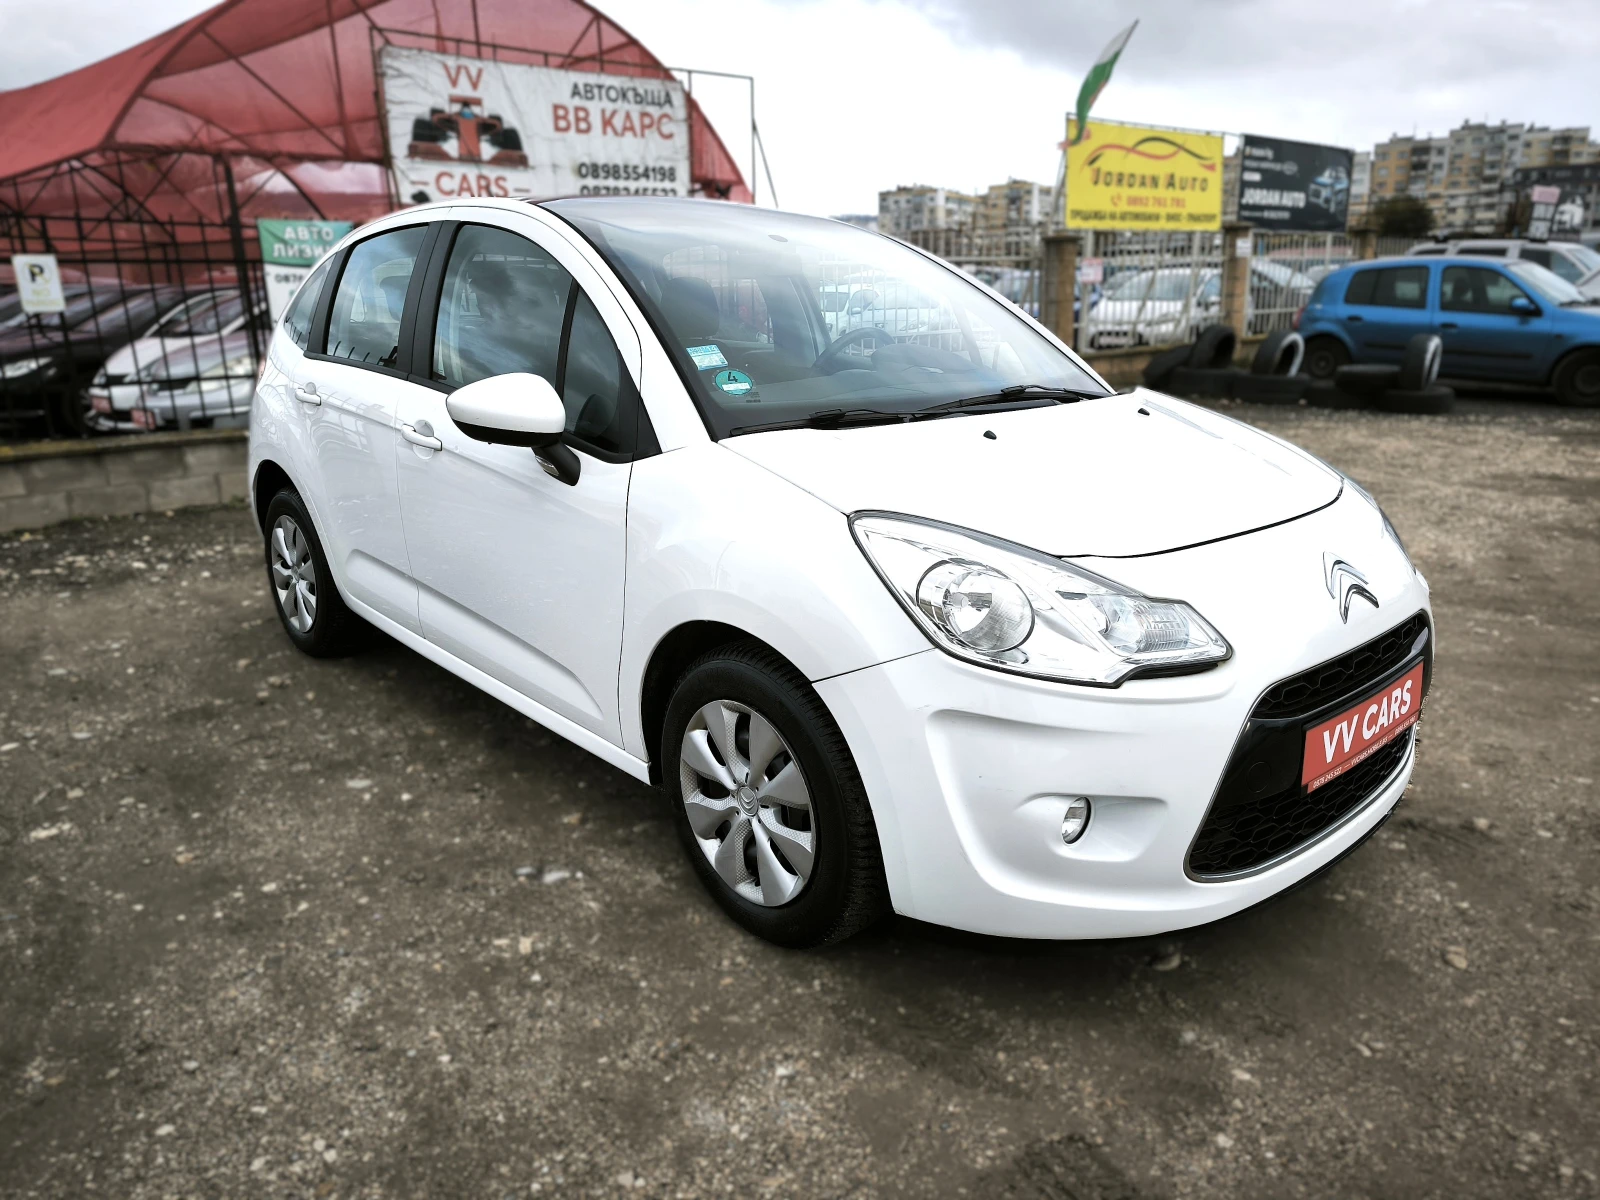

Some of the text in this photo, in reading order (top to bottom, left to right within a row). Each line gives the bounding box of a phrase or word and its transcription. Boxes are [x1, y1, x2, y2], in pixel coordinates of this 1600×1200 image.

[442, 62, 483, 91] VV
[571, 82, 674, 107] АВТОКЪЩА
[552, 104, 675, 139] ВВ КАРС
[435, 171, 509, 198] CARS
[579, 163, 676, 182] 0898554198
[1092, 168, 1160, 189] JORDAN
[284, 226, 334, 241] АВТО
[728, 372, 738, 382] 4
[1323, 679, 1413, 764] VV CARS
